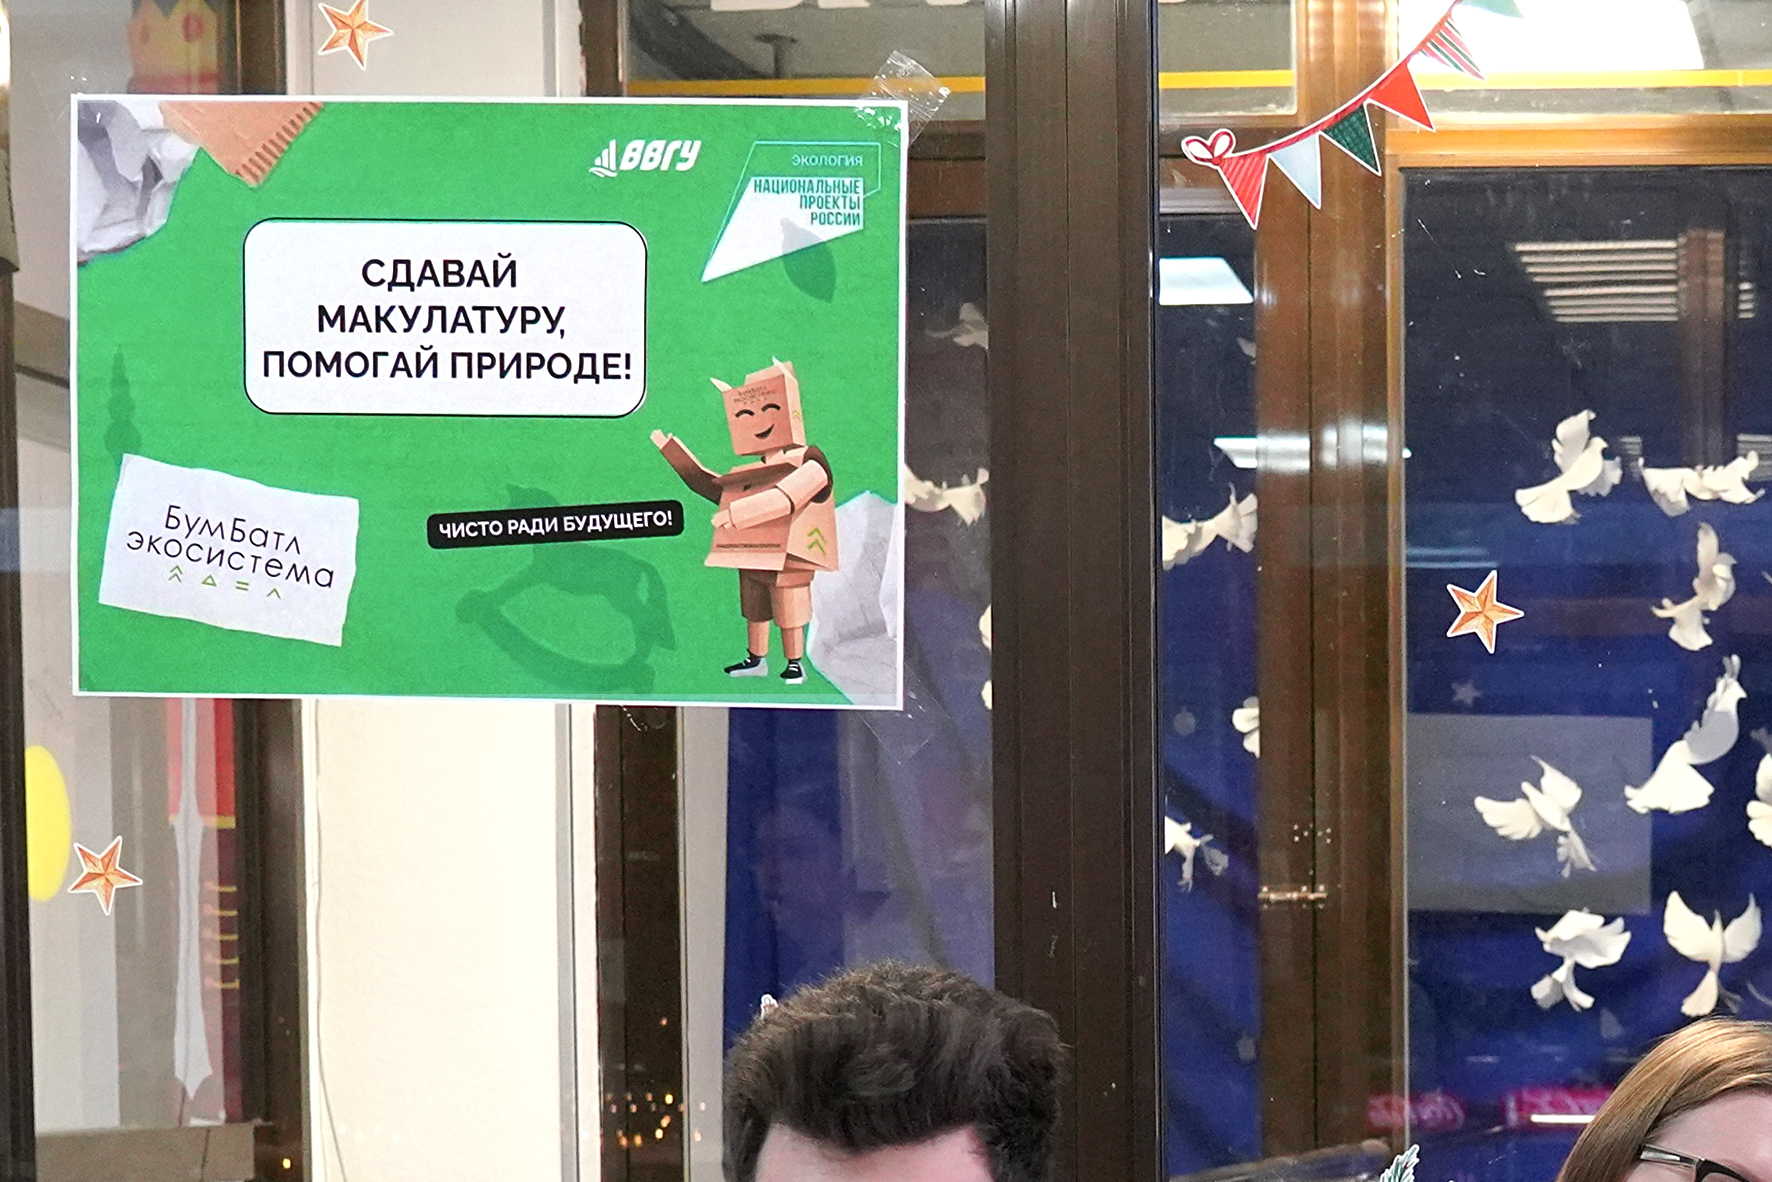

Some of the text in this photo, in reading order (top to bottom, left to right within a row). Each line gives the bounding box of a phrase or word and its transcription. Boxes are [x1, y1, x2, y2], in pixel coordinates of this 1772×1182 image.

[619, 139, 702, 171] ВВГУ
[753, 178, 861, 195] НАЦИОНАЛЬНЫЕ
[799, 195, 861, 210] ПРОЕКТЫ
[810, 211, 861, 226] РОССИИ
[361, 252, 518, 292] СДАВАЙ
[317, 304, 566, 339] МАКУЛАТУРУ,
[262, 344, 632, 385] ПОМОГАЙ ПРИРОДЕ!
[165, 504, 301, 555] БумБатл
[439, 510, 673, 539] ЧИСТО РАДИ БУДУЩЕГО!
[126, 531, 334, 589] экосистема
